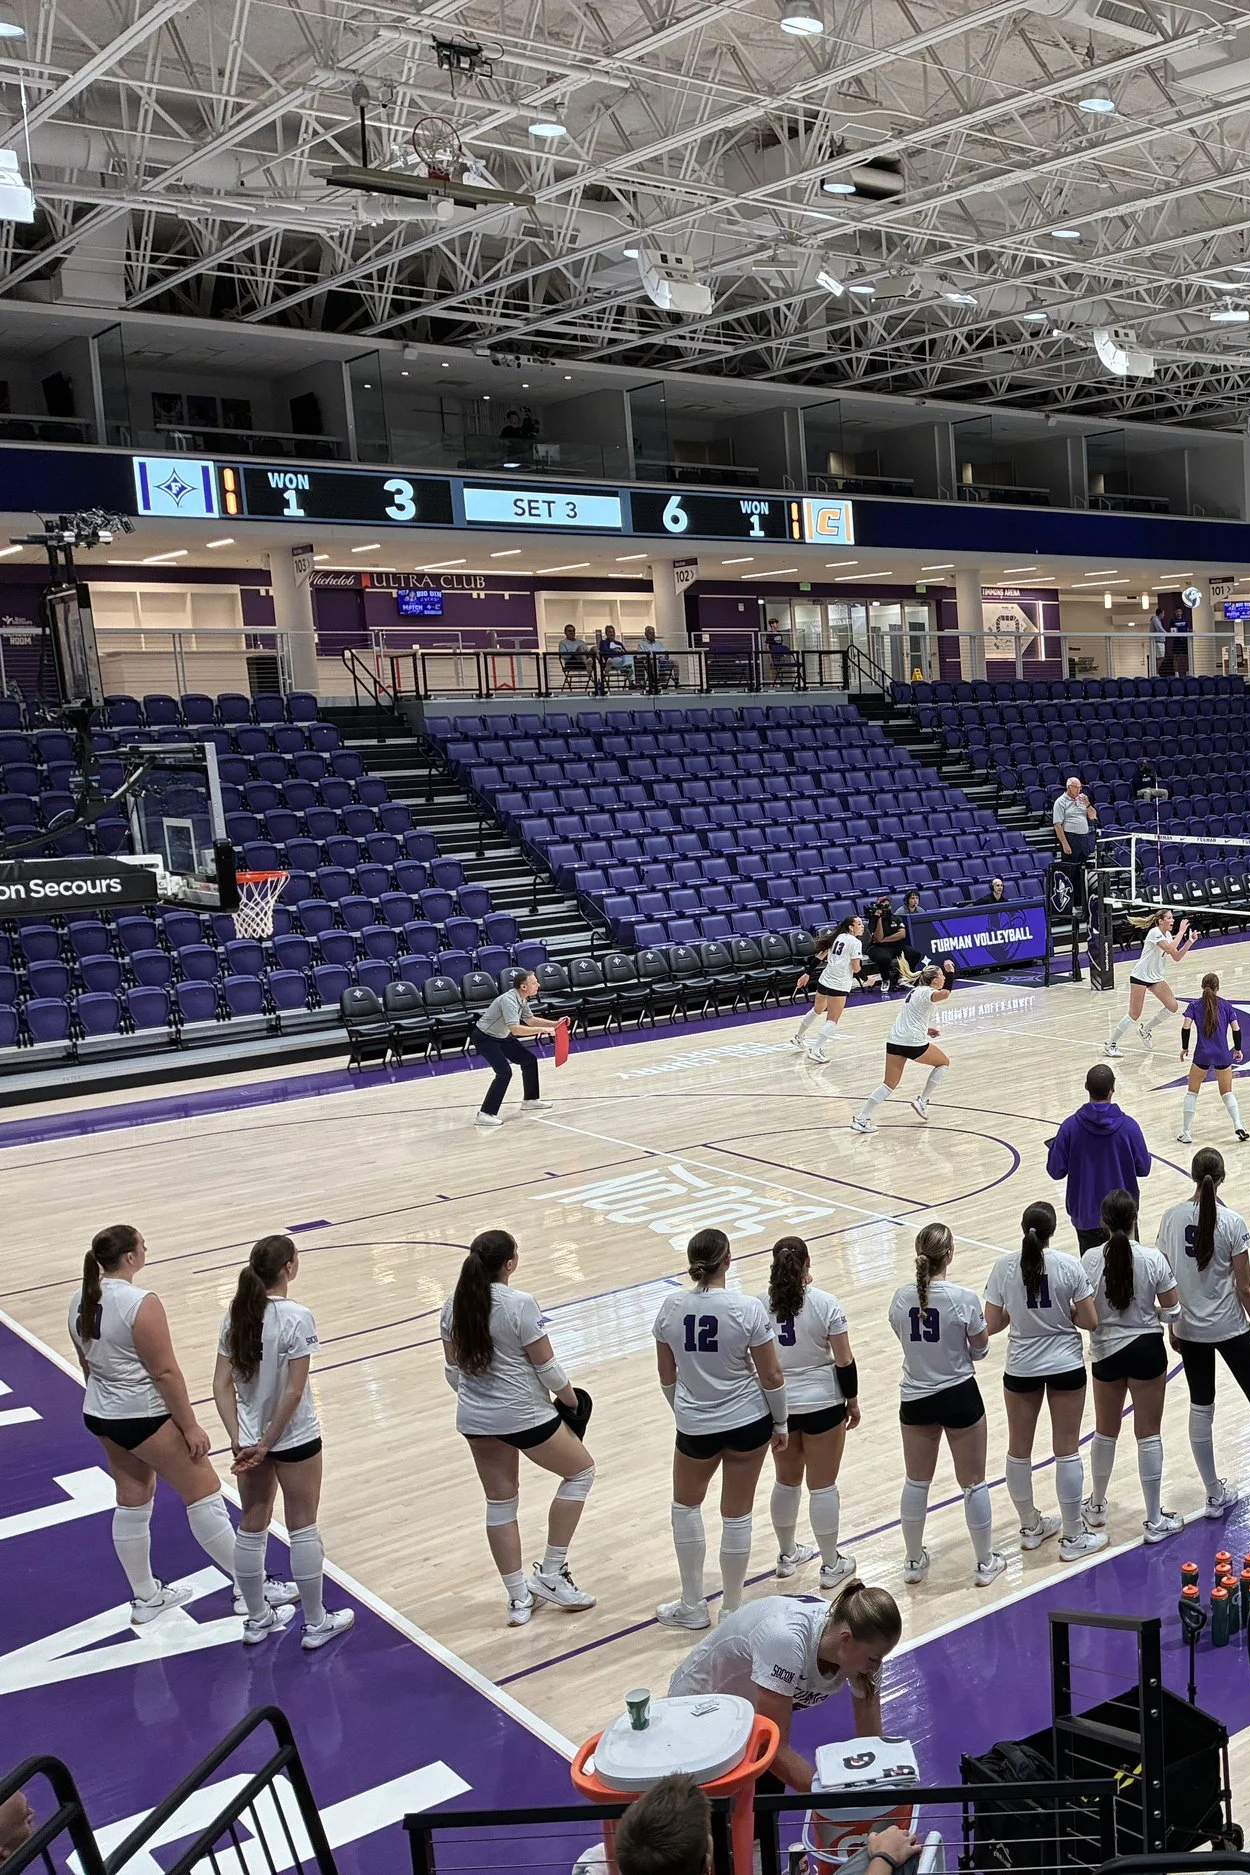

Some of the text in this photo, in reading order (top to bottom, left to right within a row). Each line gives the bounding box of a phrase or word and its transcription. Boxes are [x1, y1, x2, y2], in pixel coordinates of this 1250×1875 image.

[267, 472, 309, 489] WON
[283, 490, 305, 517] 1
[383, 479, 417, 521] 3
[513, 499, 578, 519] SET 3
[740, 500, 769, 515] WON
[662, 495, 688, 533] 6
[749, 515, 765, 536] 1
[294, 559, 307, 573] 103
[308, 572, 486, 589] Michelob ULTRA CLUB
[676, 570, 690, 584] 102
[1004, 589, 1021, 597] ARENA
[1211, 586, 1225, 596] 101
[9, 637, 32, 645] ROOM
[0, 878, 122, 900] on Secours
[832, 940, 845, 956] 13
[930, 926, 1033, 954] FURMAN VOLLEYBALL
[683, 1314, 719, 1353] 12
[777, 1314, 797, 1347] 3
[908, 1306, 942, 1343] 19
[771, 1664, 796, 1684] SOCON
